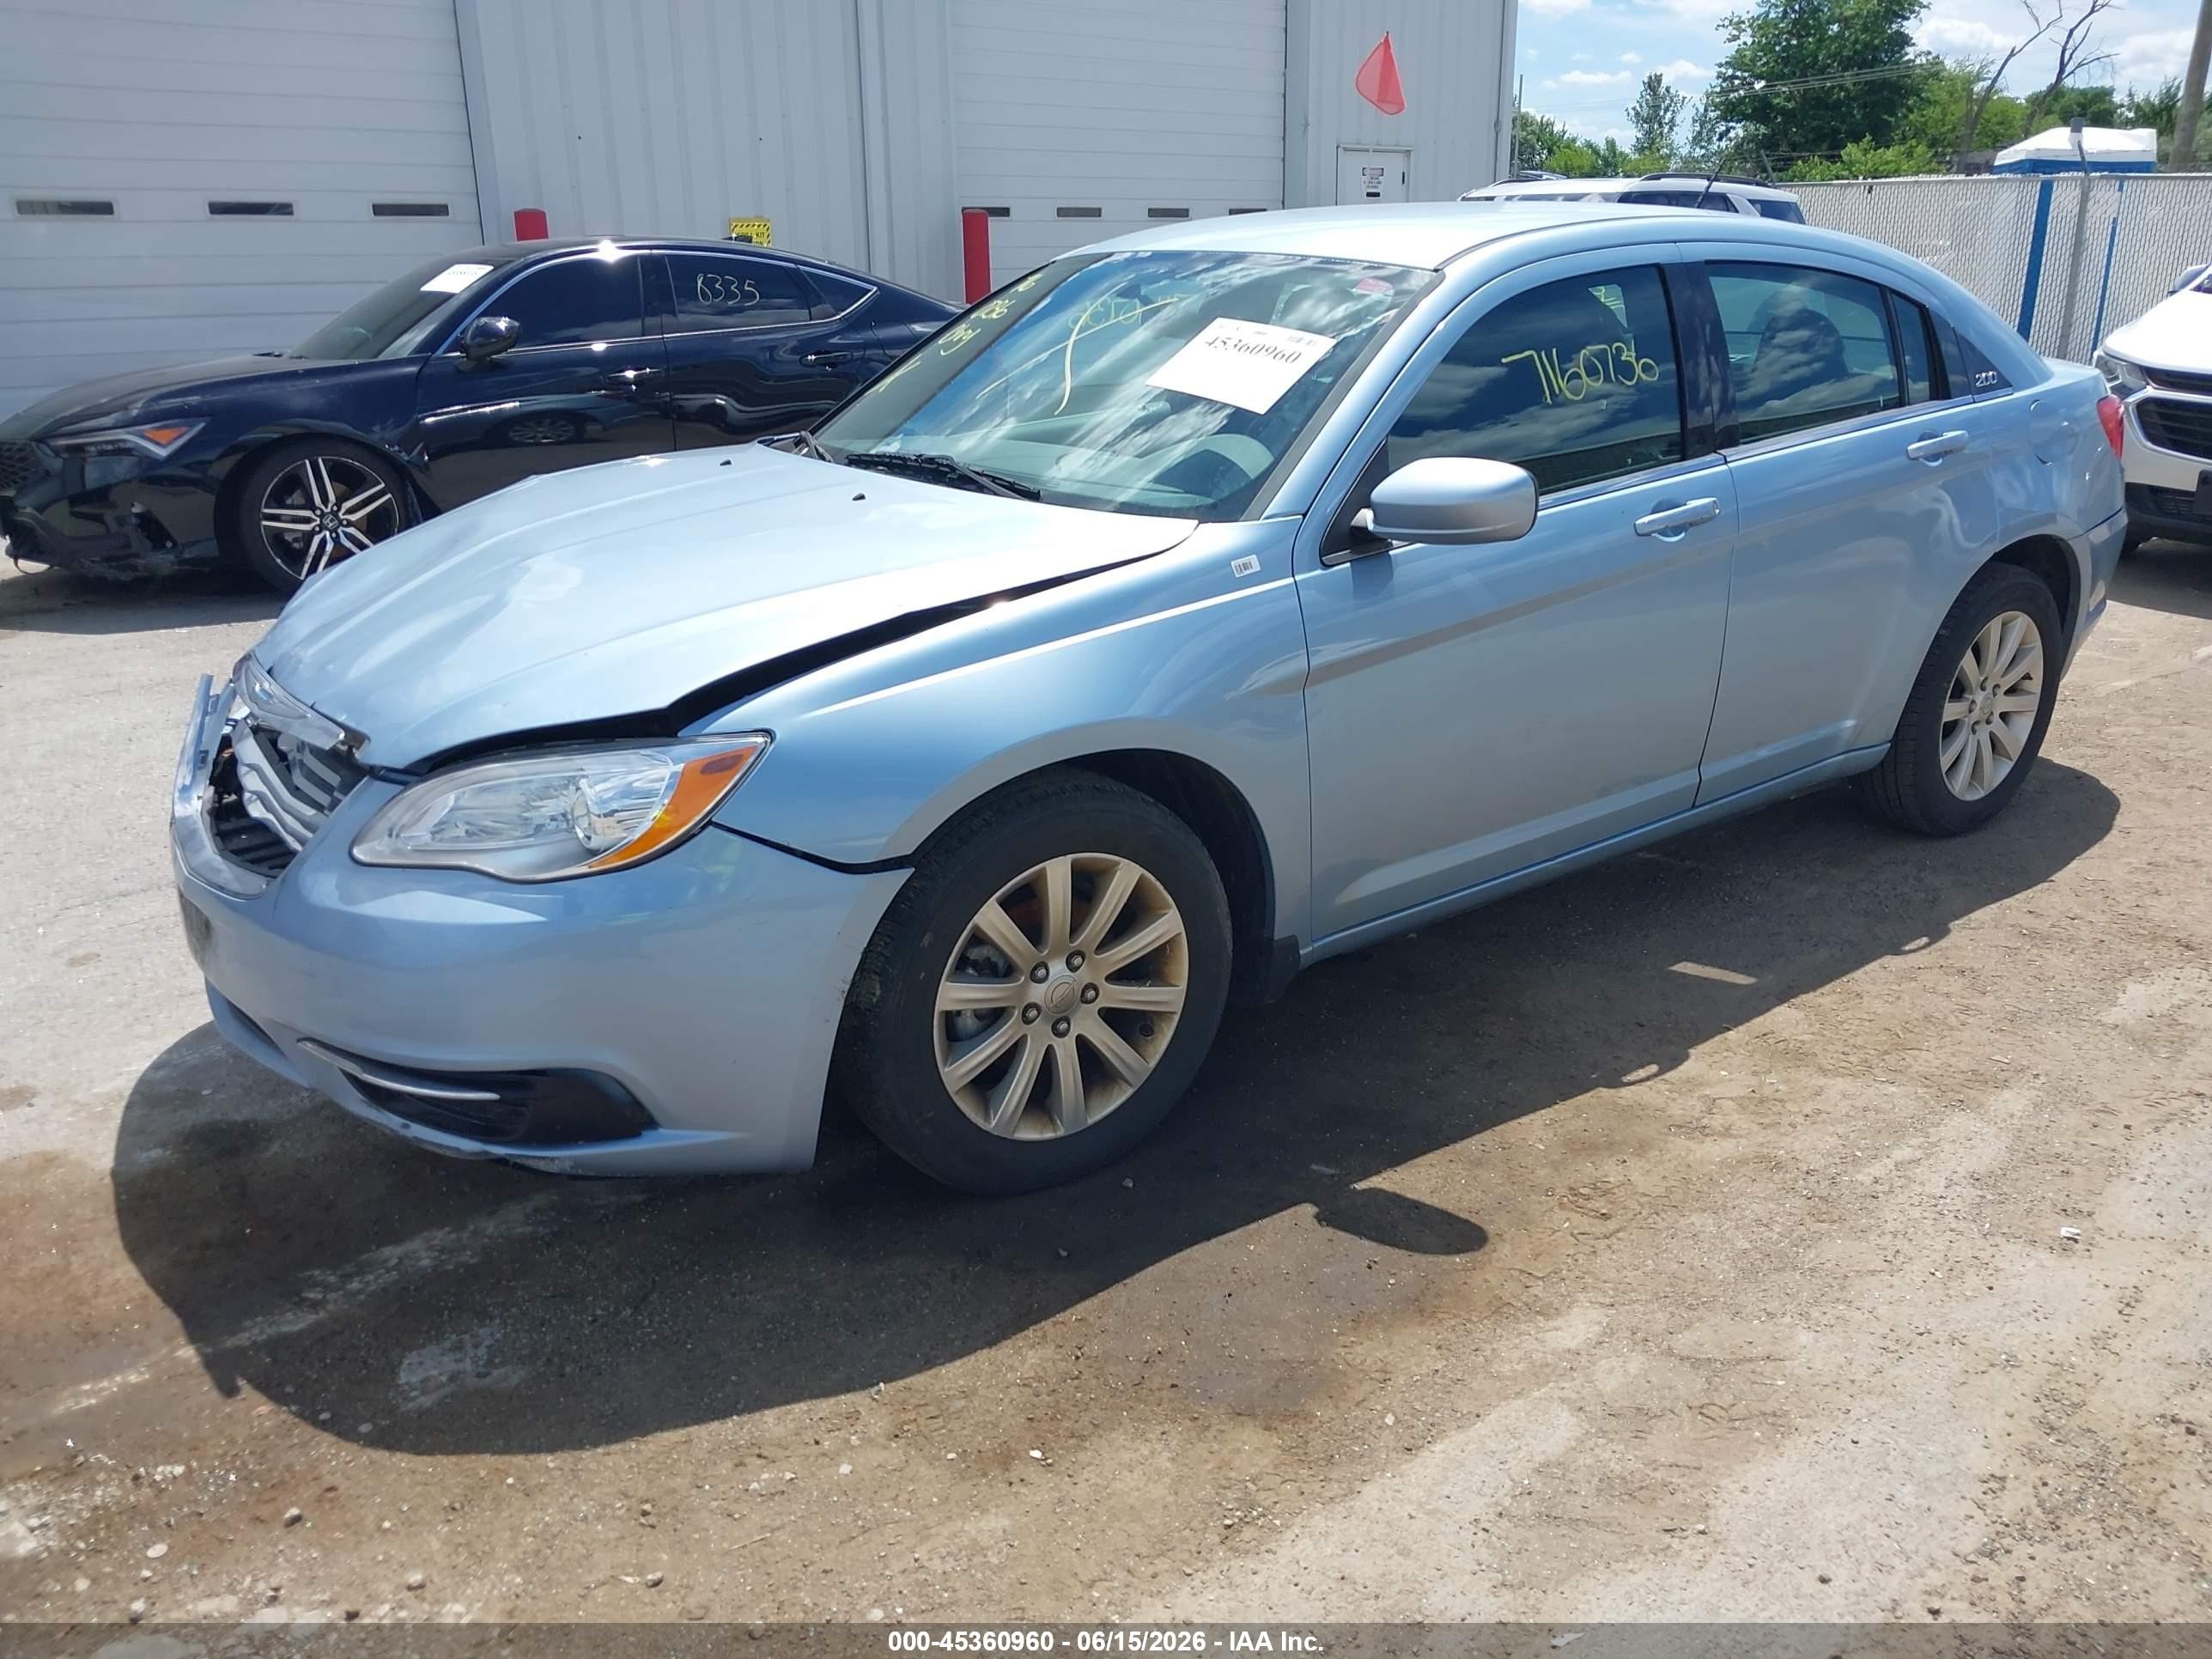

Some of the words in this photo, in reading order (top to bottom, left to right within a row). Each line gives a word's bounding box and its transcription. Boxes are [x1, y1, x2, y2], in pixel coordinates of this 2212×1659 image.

[696, 273, 760, 307] 8335
[1205, 336, 1303, 364] 45360960
[1501, 342, 1659, 405] 7160736
